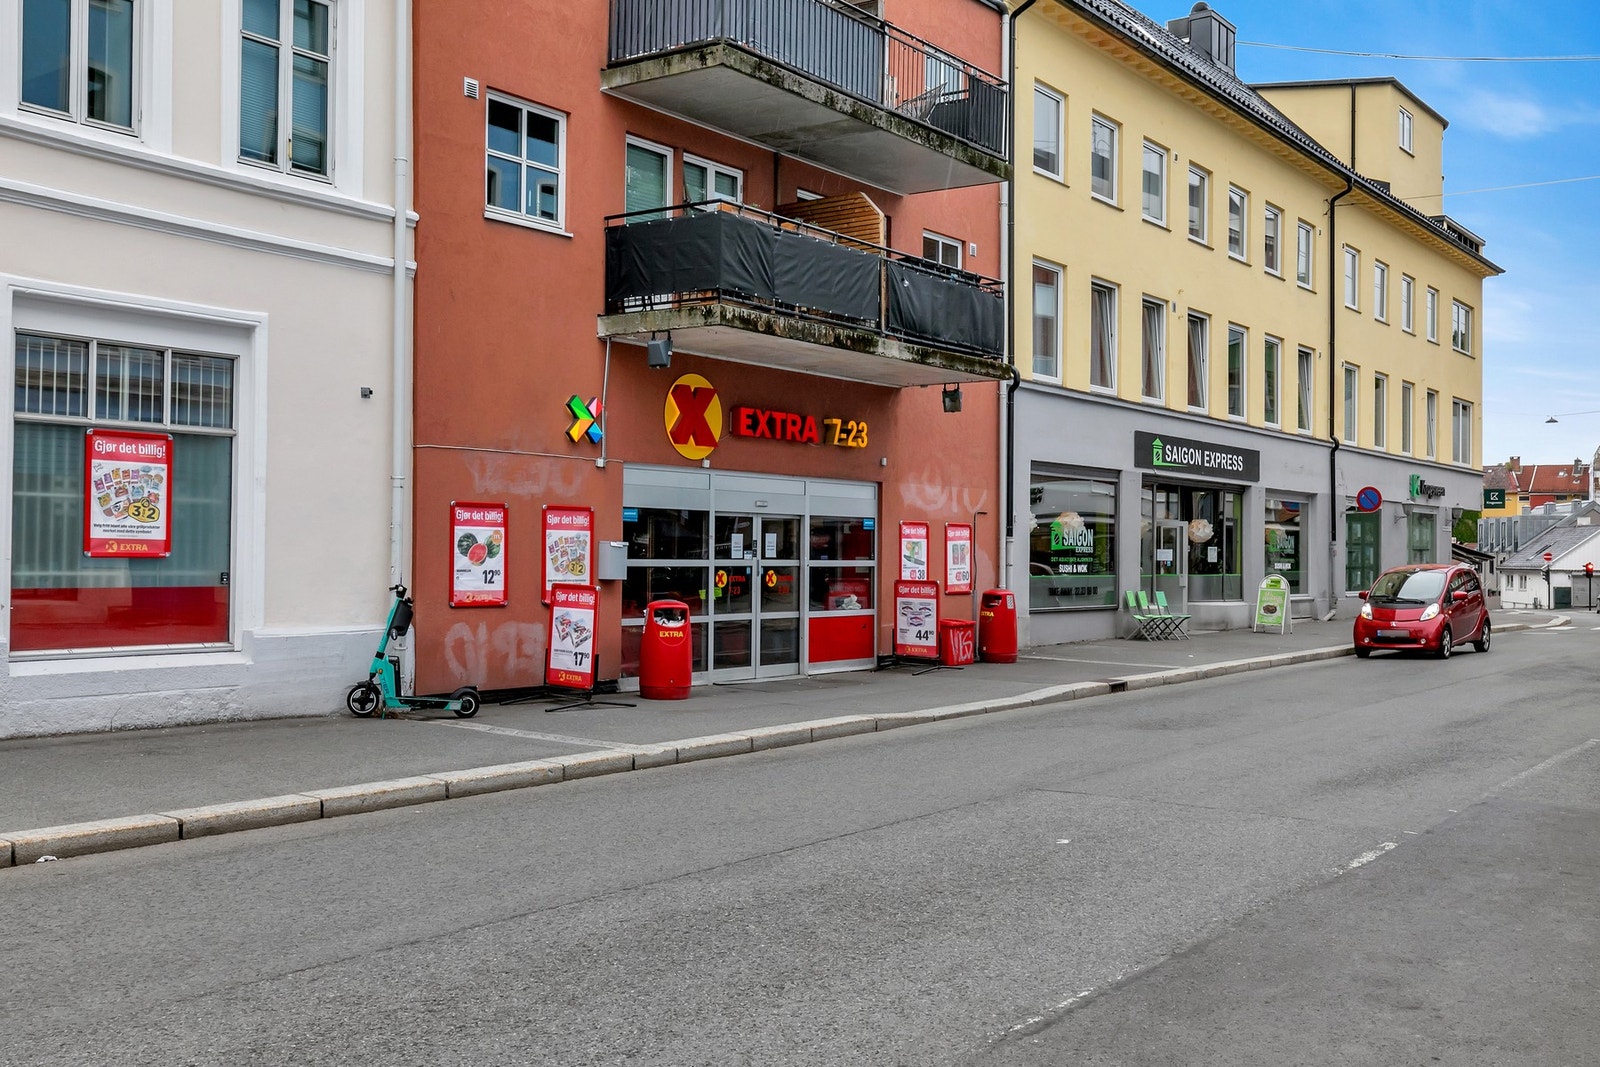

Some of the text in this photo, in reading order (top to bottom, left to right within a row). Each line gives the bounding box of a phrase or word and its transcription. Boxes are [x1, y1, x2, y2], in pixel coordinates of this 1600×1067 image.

[737, 406, 820, 444] EXTRA
[823, 418, 868, 448] 7-23
[94, 440, 166, 458] Gjør det billig!
[1165, 444, 1243, 472] SAIGON EXPRESS
[131, 505, 141, 517] 3
[146, 507, 156, 520] 2
[456, 509, 504, 523] Gjør det billig!
[547, 514, 590, 527] Gjør det billig!
[1063, 529, 1094, 547] SAIGON
[120, 543, 148, 552] EXTRA
[1075, 546, 1094, 554] EXPRESS
[1058, 564, 1073, 573] SUSHI
[899, 585, 937, 596] Gjør det billig!
[555, 591, 596, 605] Gjør det billig!
[659, 630, 684, 638] EXTRA
[566, 674, 583, 683] EXTRA
